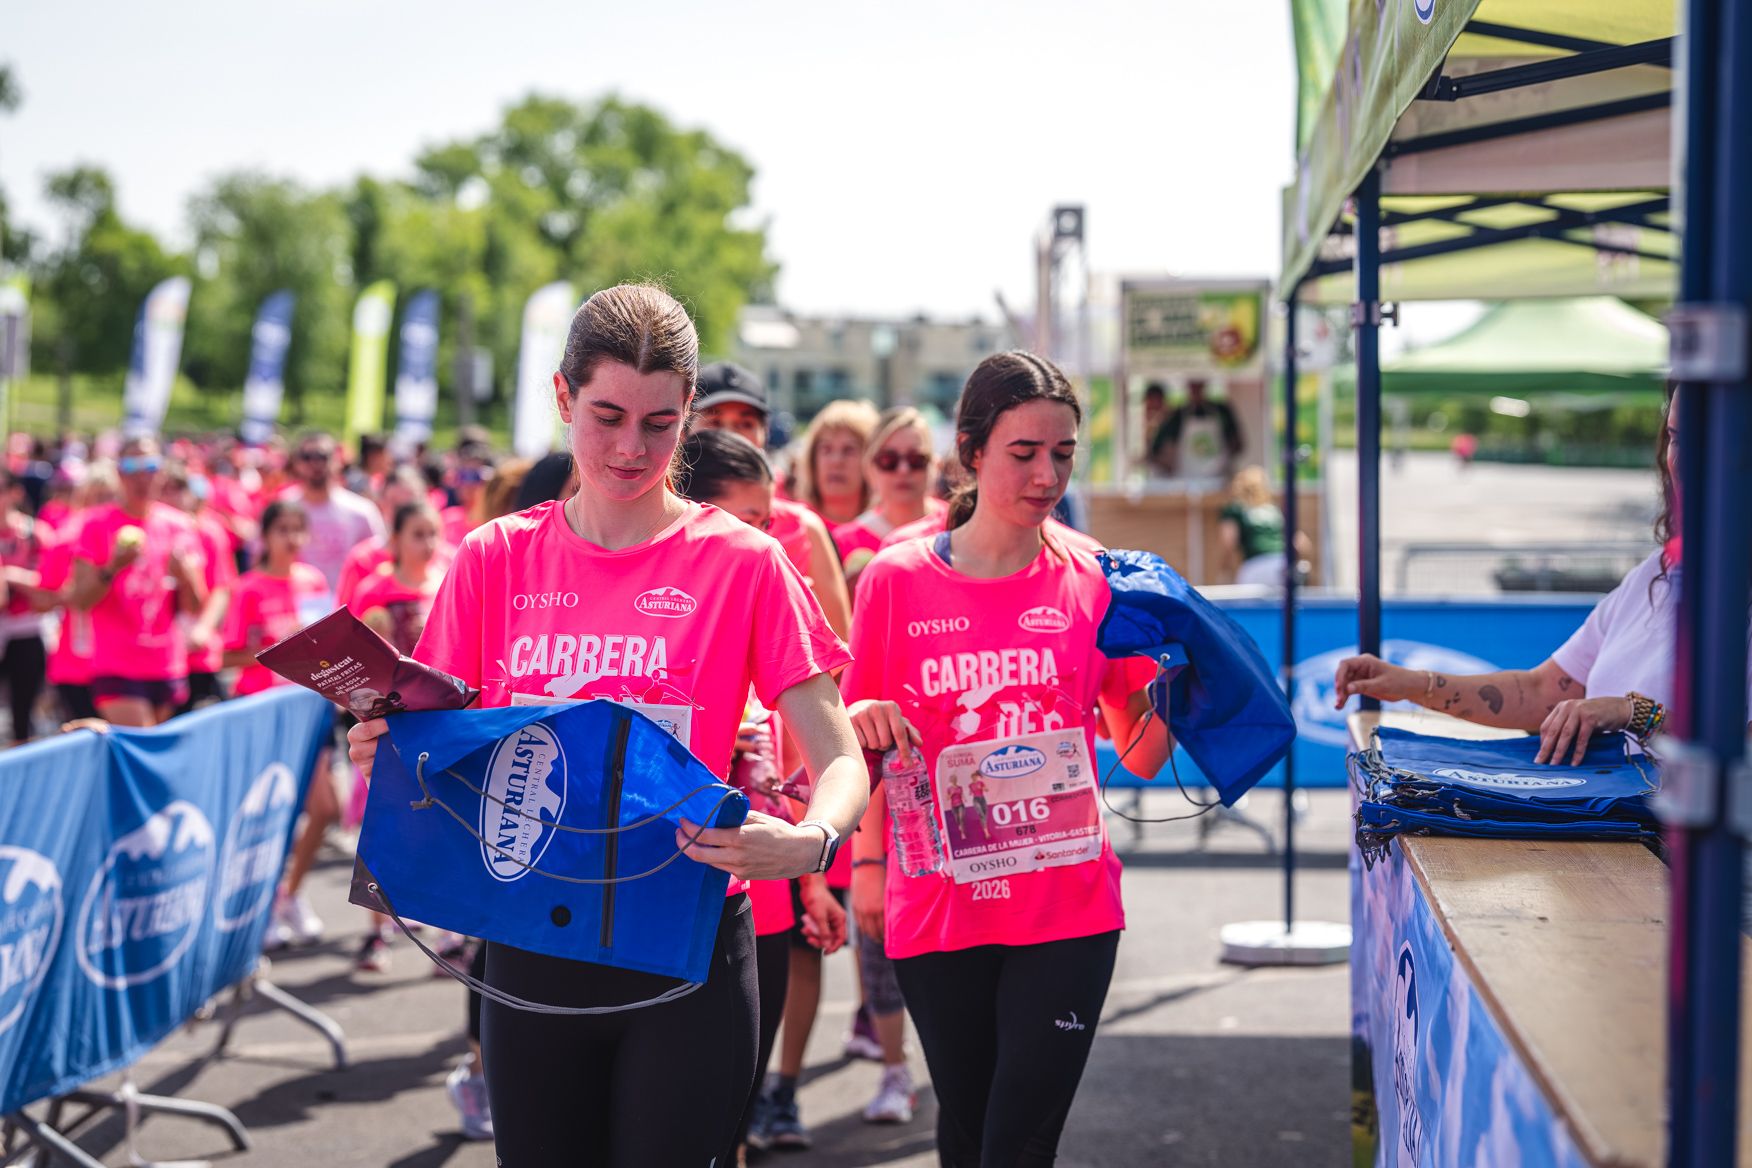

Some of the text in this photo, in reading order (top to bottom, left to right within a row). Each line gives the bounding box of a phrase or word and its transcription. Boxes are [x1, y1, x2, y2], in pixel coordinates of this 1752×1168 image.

[513, 592, 579, 611] OYSHO
[638, 597, 692, 612] ASTURIANA
[907, 616, 970, 637] OYSHO
[510, 633, 668, 679] CARRERA
[316, 675, 342, 688] PATATAS
[340, 661, 363, 677] FRITAS
[921, 647, 1059, 697] CARRERA
[985, 756, 1043, 773] ASTURIANA
[526, 752, 546, 804] CENTRAL
[1449, 771, 1572, 786] ASTURIANA
[493, 728, 549, 864] ASTURIANA
[992, 797, 1051, 825] 016
[1015, 825, 1037, 836] 678
[953, 845, 988, 858] CARRERA
[987, 842, 998, 852] DE
[998, 841, 1009, 850] LA
[1008, 837, 1034, 848] MUJER
[1046, 846, 1090, 860] Santander
[969, 856, 1018, 873] OYSHO
[971, 879, 1011, 900] 2026
